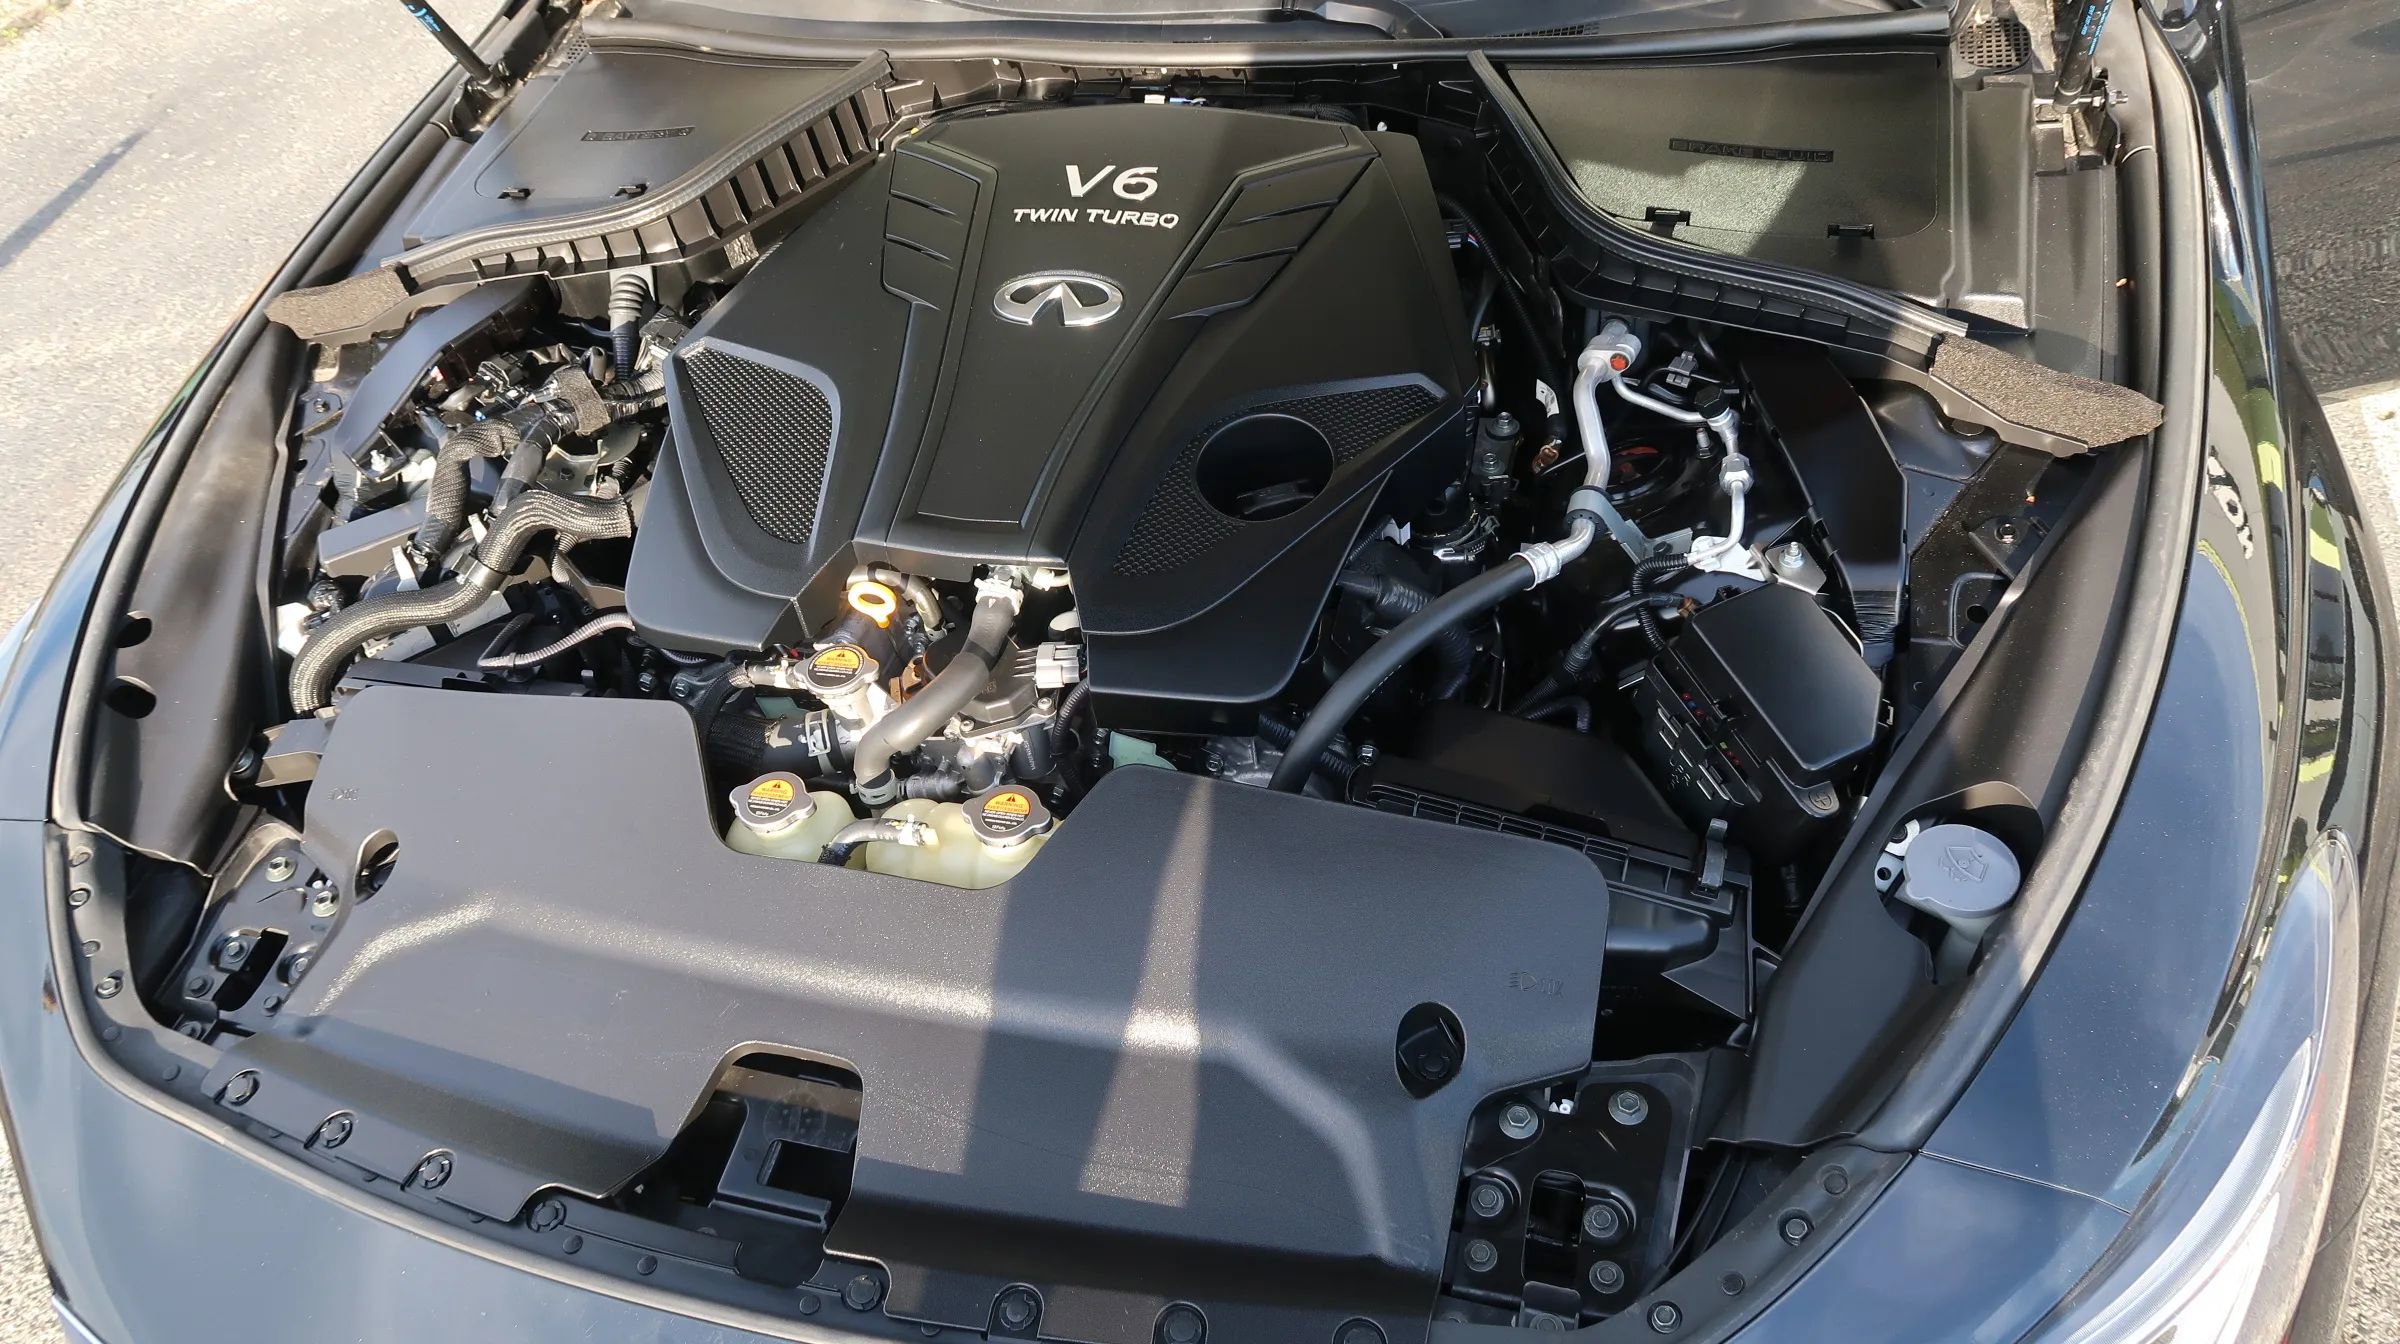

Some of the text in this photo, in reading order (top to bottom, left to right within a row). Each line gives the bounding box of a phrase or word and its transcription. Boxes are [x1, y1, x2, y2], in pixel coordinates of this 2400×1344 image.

[1065, 164, 1159, 201] V6
[1013, 208, 1179, 229] TWIN TURBO
